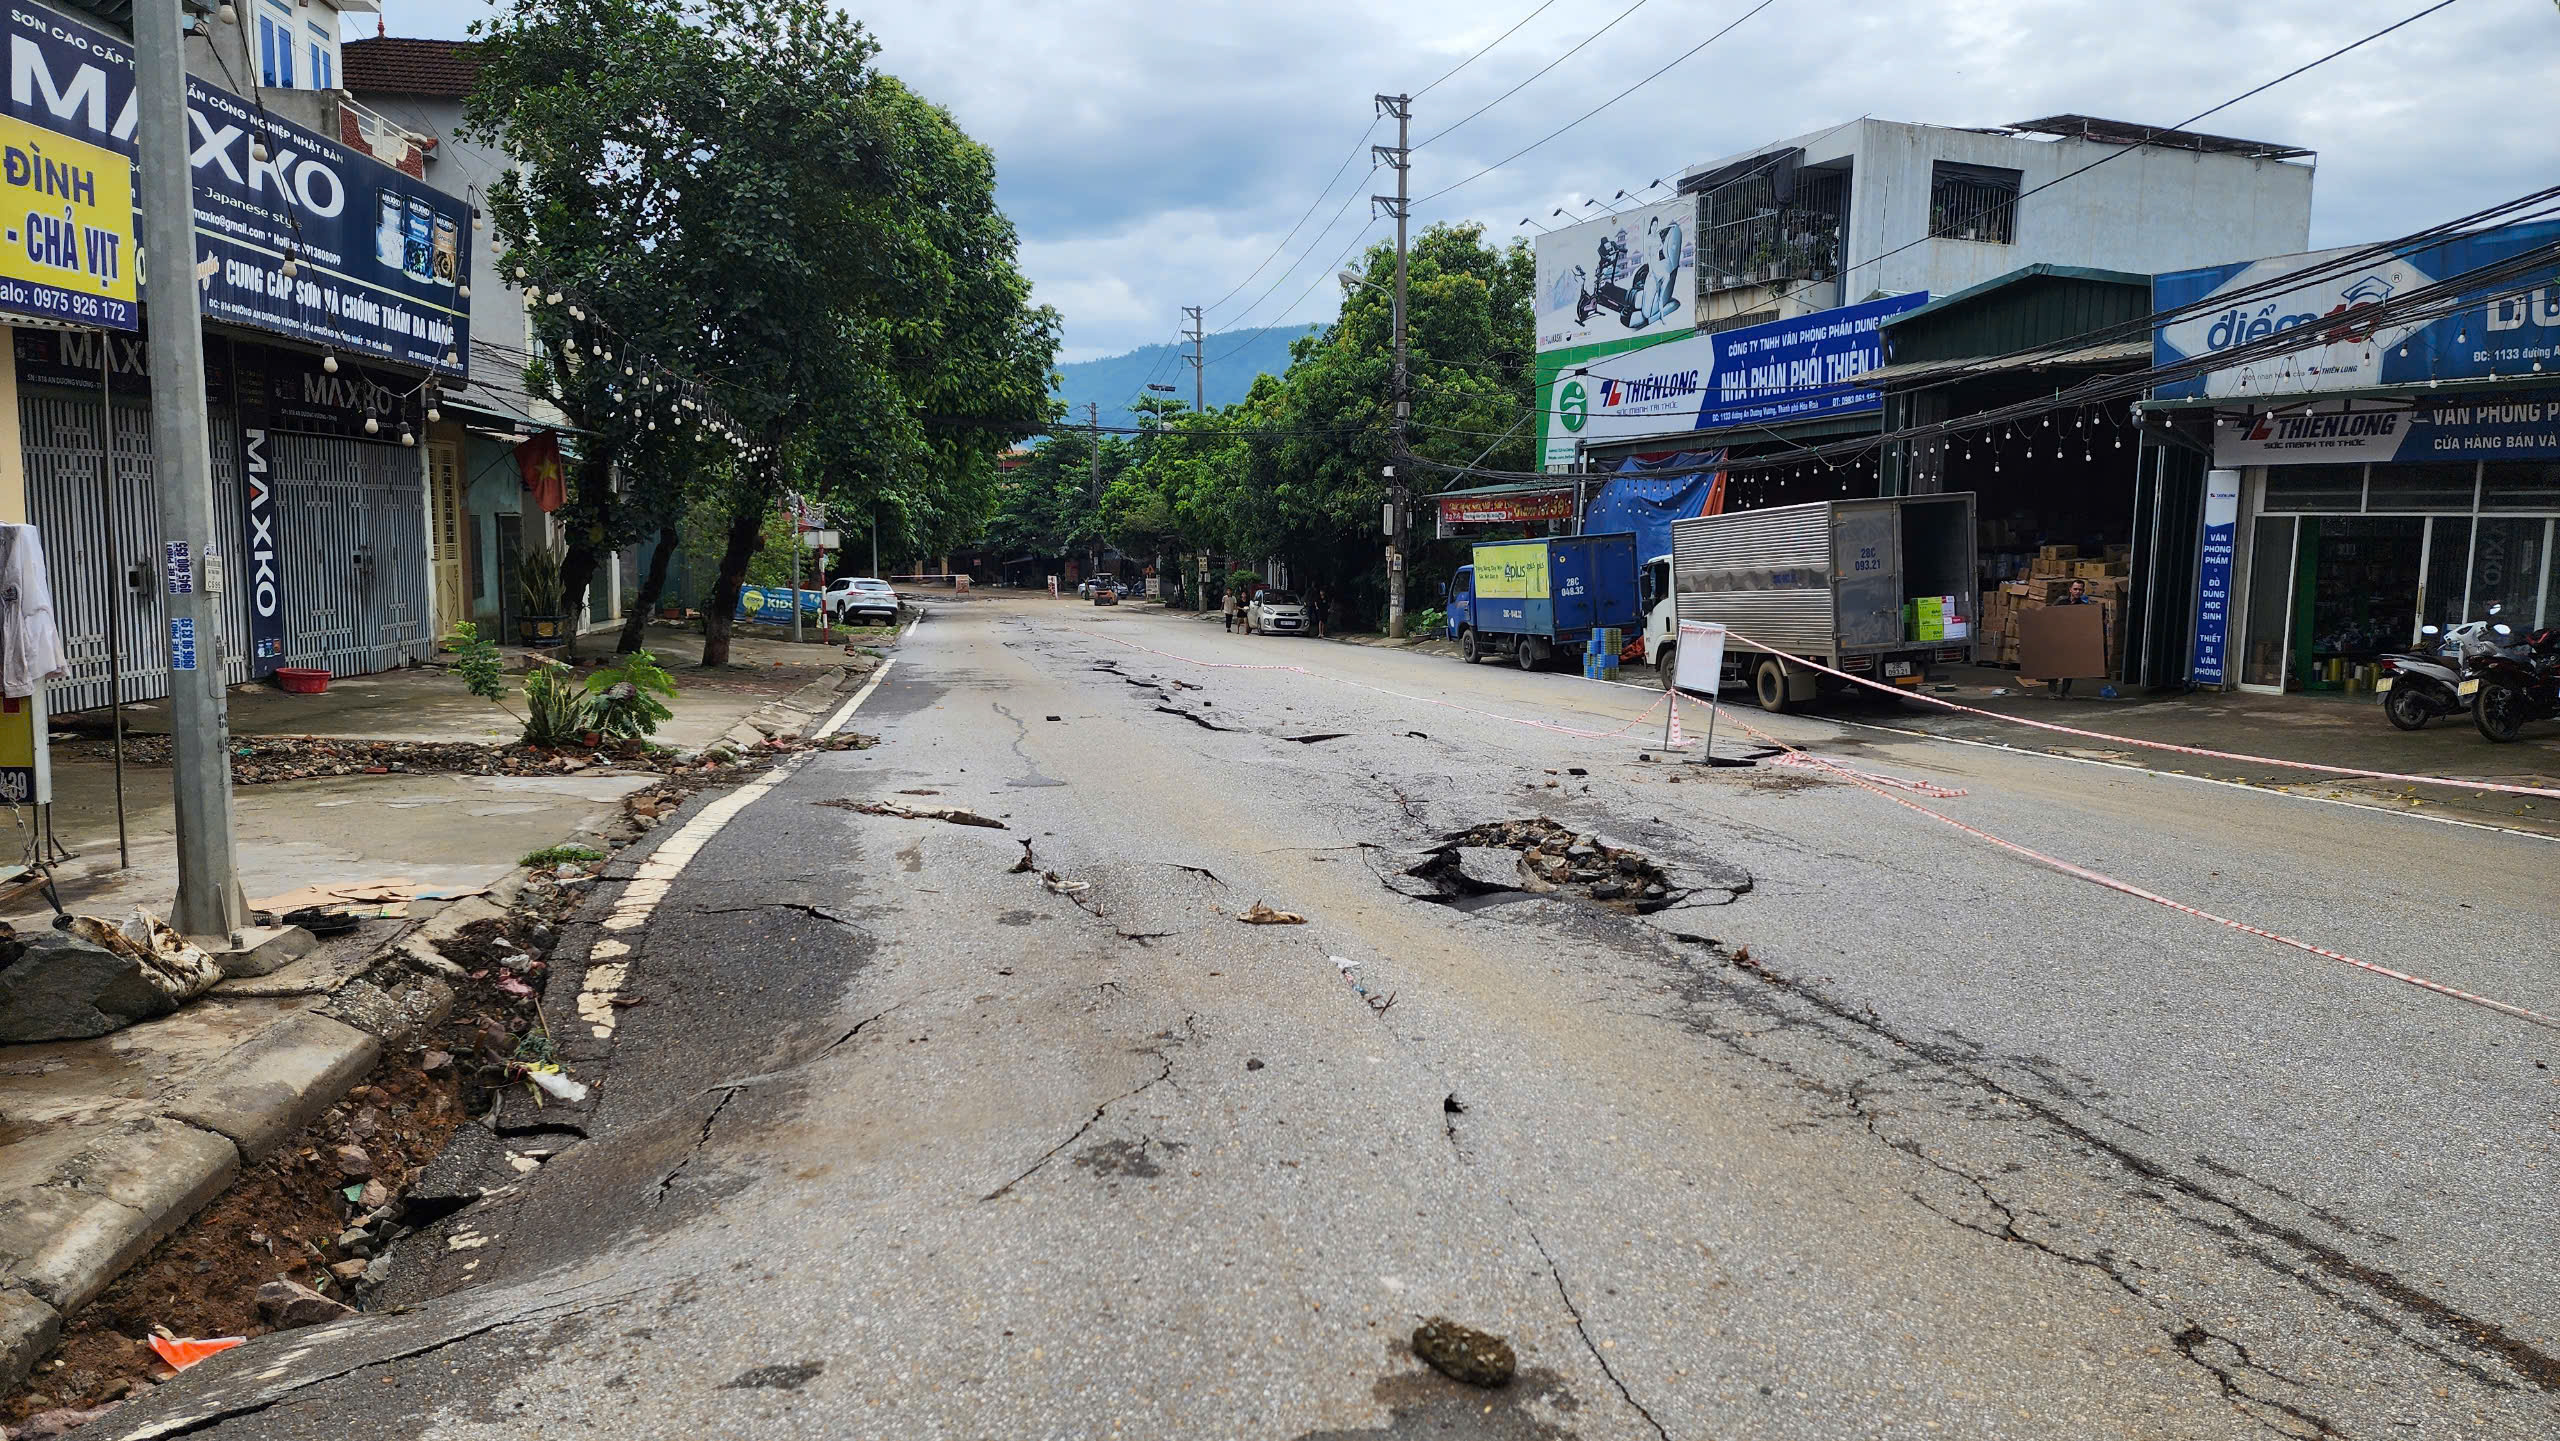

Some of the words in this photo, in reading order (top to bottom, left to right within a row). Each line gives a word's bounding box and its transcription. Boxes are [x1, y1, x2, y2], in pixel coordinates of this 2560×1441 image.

[11, 9, 46, 33] SƠN
[52, 28, 87, 50] CAO
[92, 45, 125, 65] CẤP
[209, 95, 247, 120] CÔNG
[249, 114, 291, 139] NGHIỆP
[293, 134, 321, 154] NHẬT
[323, 146, 344, 164] BẢN
[3, 141, 96, 207] ĐÌNH
[205, 186, 269, 218] Japanese
[26, 206, 80, 271] CHẢ
[84, 227, 119, 288] VỊT
[0, 281, 29, 305] alo:
[33, 287, 69, 313] 0975
[72, 293, 98, 317] 926
[101, 300, 126, 322] 172
[226, 258, 264, 294] CUNG
[296, 280, 321, 310] SƠN
[324, 286, 340, 315] VÀ
[342, 292, 380, 326] CHỐNG
[382, 303, 411, 335] THẤM
[428, 318, 454, 346] NĂNG
[252, 310, 261, 319] AN
[2207, 304, 2318, 351] điểm
[1728, 340, 1748, 357] CÔNG
[1749, 340, 1758, 353] TY
[1760, 336, 1780, 350] TNHH
[1782, 330, 1798, 347] VĂN
[1799, 325, 1827, 344] PHÒNG
[1828, 317, 1853, 338] PHẨM
[1854, 317, 1878, 334] DUNG
[2473, 351, 2491, 362] ĐC:
[2494, 348, 2519, 360] 1133
[2522, 347, 2550, 359] đường
[1721, 361, 1747, 402] NHÀ
[1751, 355, 1787, 399] PHÂN
[1790, 343, 1822, 392] PHỐI
[1826, 340, 1870, 386] THIÊN
[2341, 365, 2358, 373] LONG
[1720, 412, 1731, 421] 1133
[1743, 409, 1750, 418] An
[2433, 400, 2470, 425] VĂN
[2476, 397, 2541, 424] PHÒNG
[2263, 440, 2285, 449] SỨC
[2285, 440, 2317, 449] MẠNH
[2338, 438, 2366, 447] THỨC
[2434, 434, 2460, 450] CỬA
[2464, 433, 2502, 449] HÀNG
[2506, 432, 2534, 448] BÁN
[2538, 431, 2557, 447] VÀ
[246, 428, 277, 617] MAXKO
[2210, 532, 2227, 542] VĂN
[1860, 548, 1876, 558] 28C
[2204, 544, 2231, 554] PHÒNG
[2205, 554, 2228, 565] PHẨM
[1855, 560, 1881, 571] 093.21
[1566, 577, 1580, 587] 28C
[2208, 576, 2220, 587] ĐỒ
[1561, 586, 1584, 597] 048.32
[2203, 588, 2225, 598] DÙNG
[2205, 601, 2221, 611] HỌC
[2202, 612, 2222, 621] SINH
[180, 618, 193, 628] 93
[180, 629, 194, 639] 83
[2200, 632, 2221, 643] THIẾT
[181, 640, 194, 650] 90
[2205, 645, 2213, 656] BỊ
[182, 650, 196, 669] 0986
[2200, 656, 2217, 665] VĂN
[2194, 666, 2222, 677] PHÒNG
